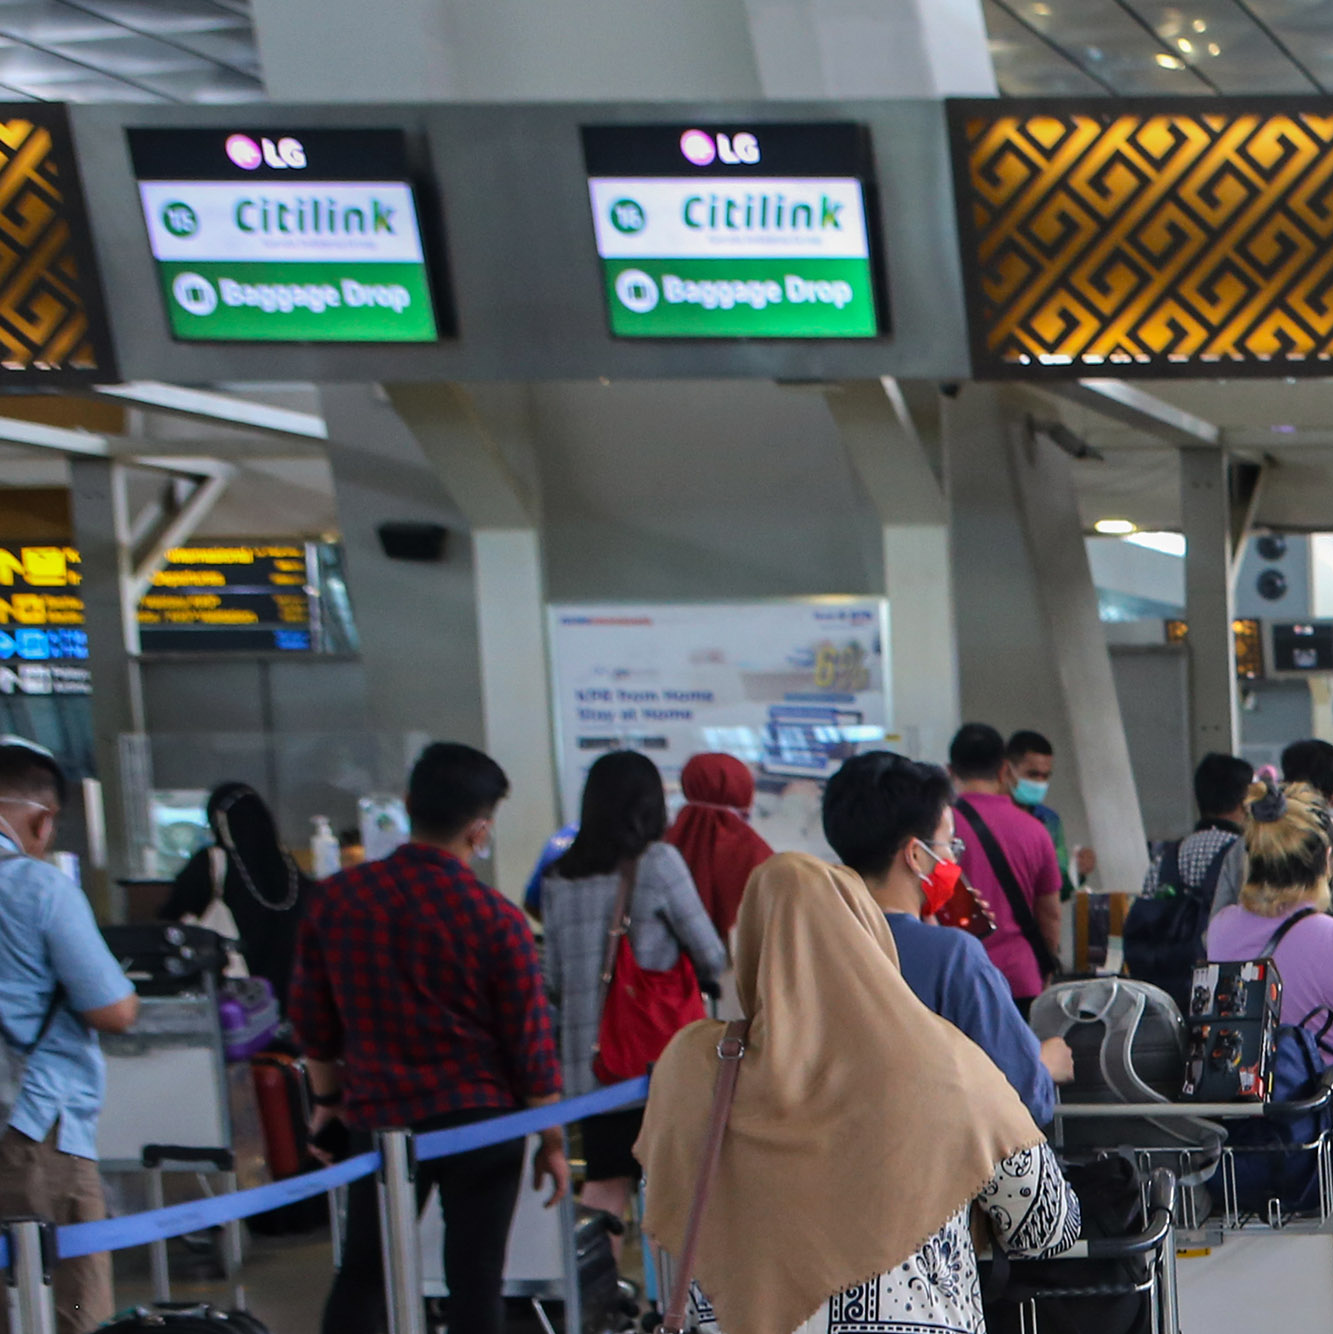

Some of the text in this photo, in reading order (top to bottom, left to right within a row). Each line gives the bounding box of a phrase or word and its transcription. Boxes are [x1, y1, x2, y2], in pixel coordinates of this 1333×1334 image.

[261, 137, 306, 168] LG
[716, 132, 760, 164] LG
[234, 198, 397, 234] Citilink
[683, 193, 846, 230] Citilink
[218, 277, 411, 313] Baggage Drop
[662, 274, 853, 309] Baggage Drop
